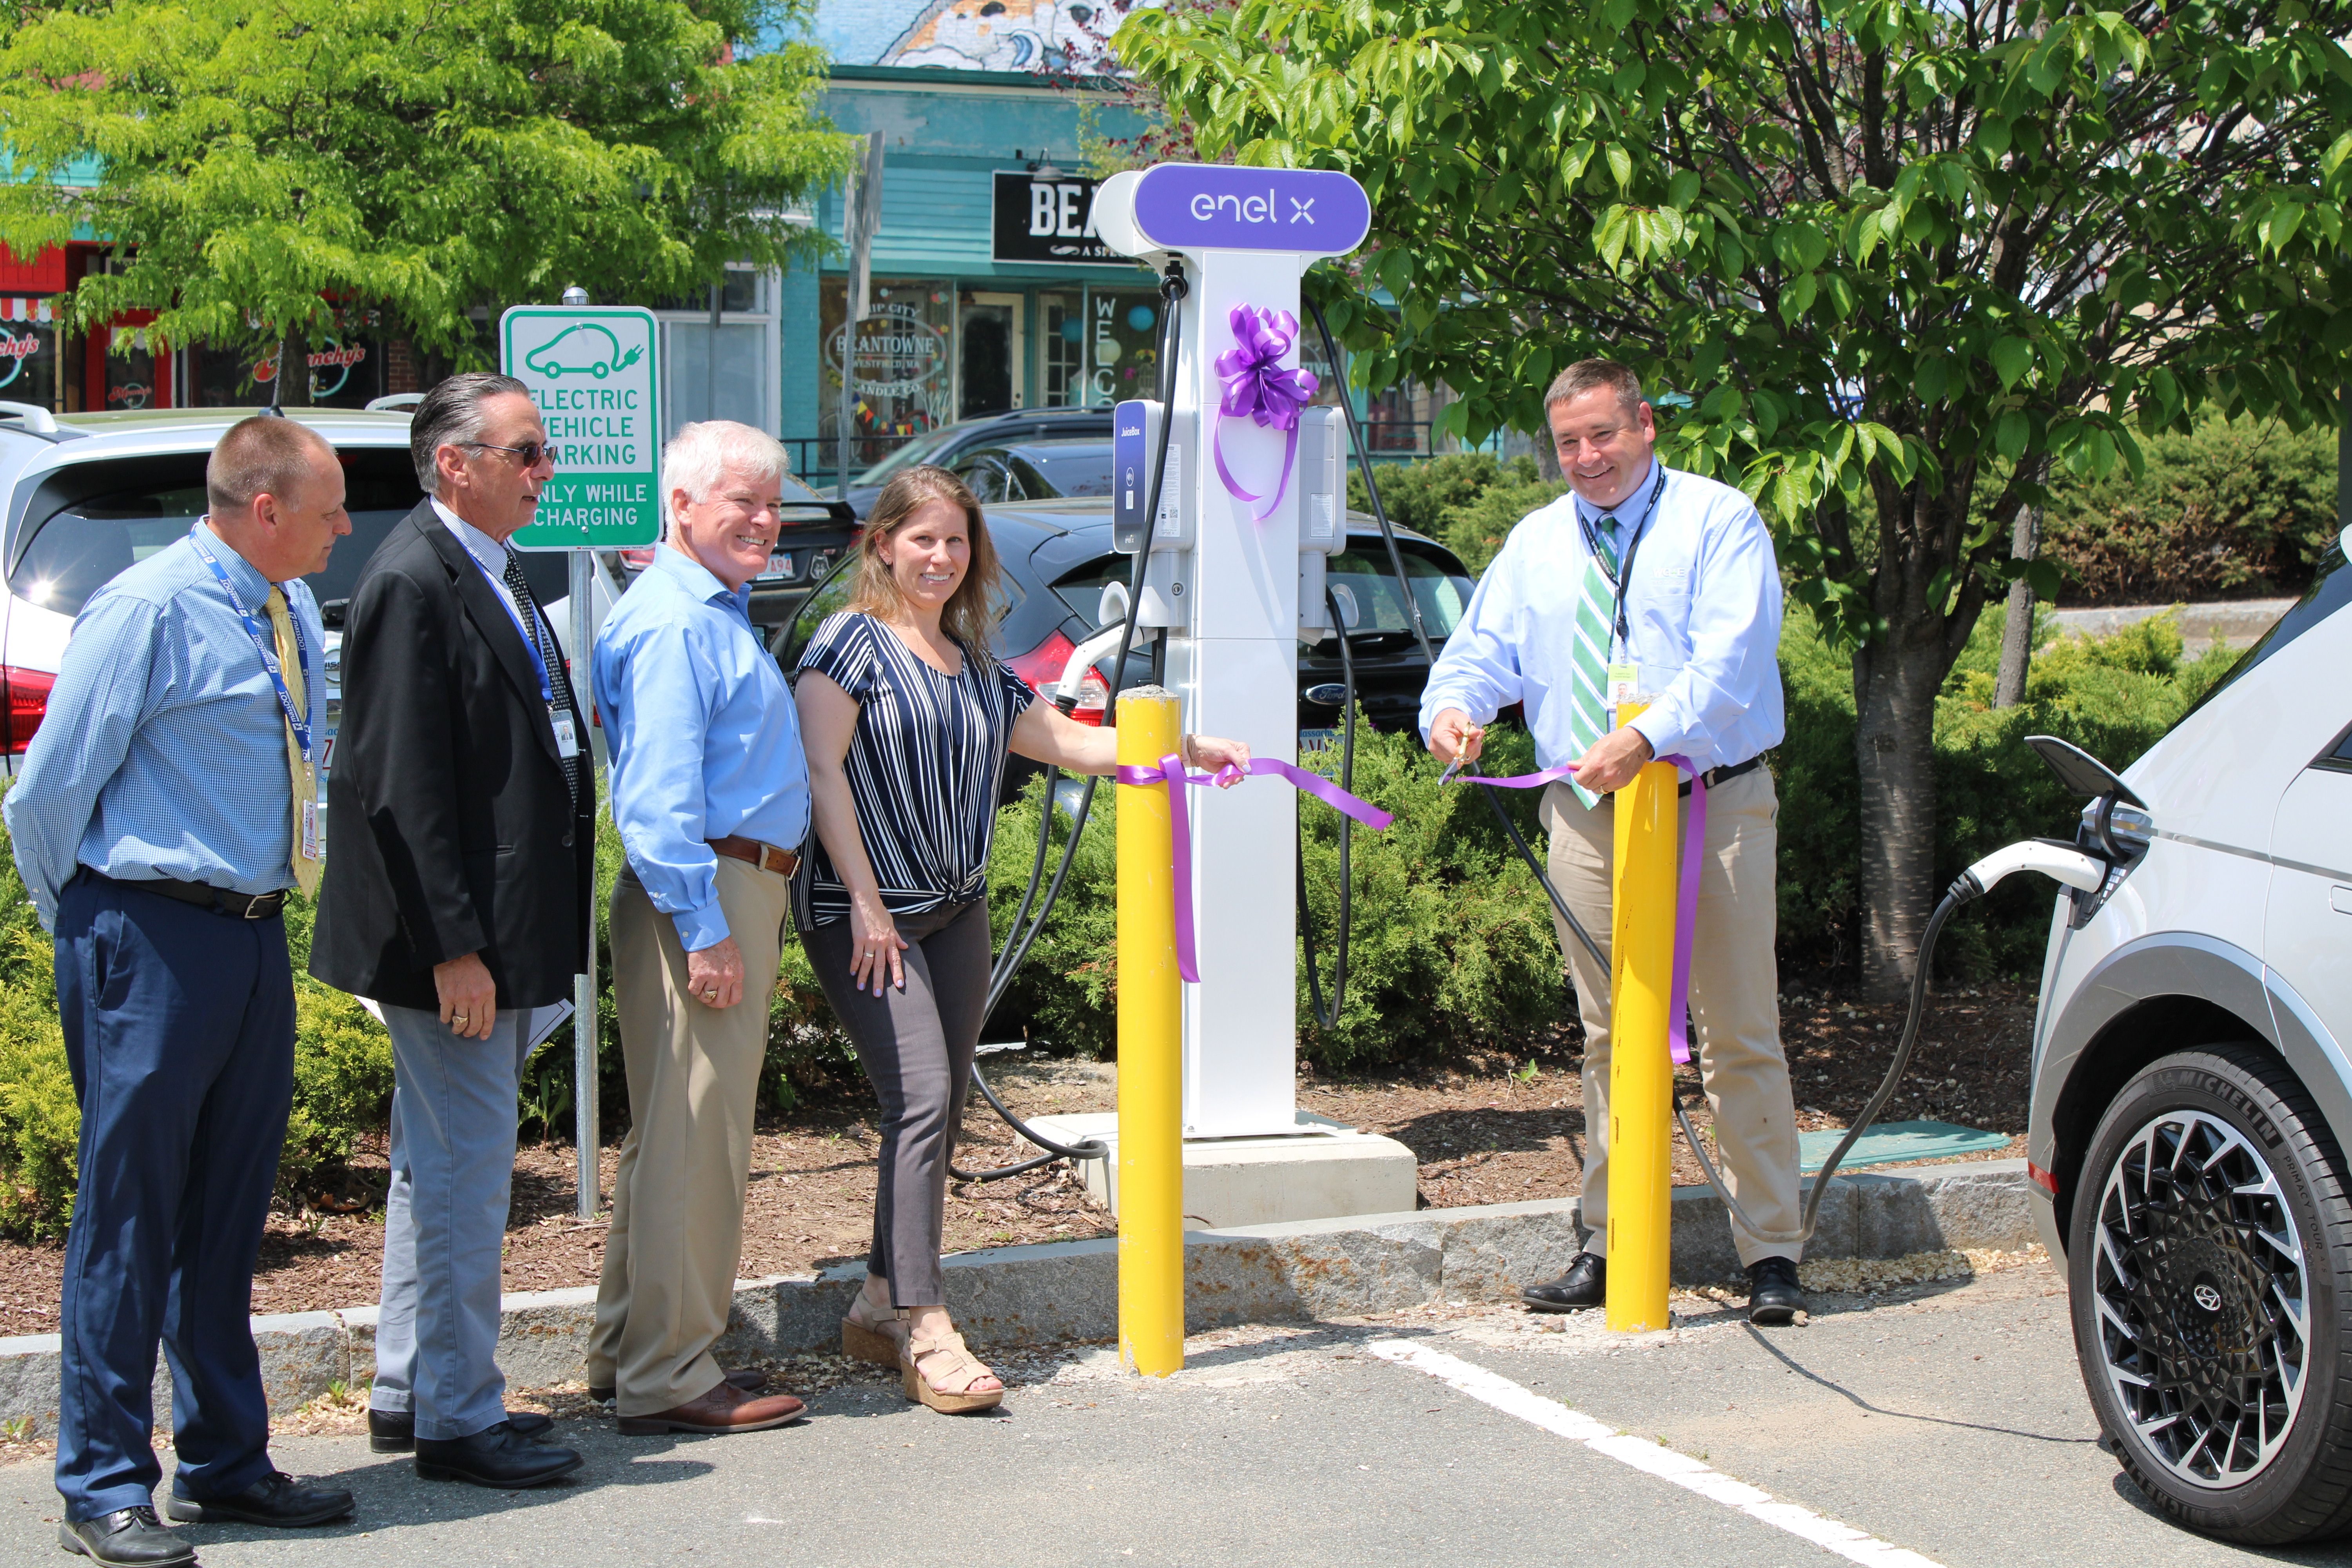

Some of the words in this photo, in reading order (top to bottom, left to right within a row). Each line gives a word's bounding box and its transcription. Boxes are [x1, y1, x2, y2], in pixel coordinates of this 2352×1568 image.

[1191, 189, 1278, 223] enel
[1290, 197, 1315, 225] x
[1082, 246, 1091, 256] A
[889, 303, 921, 318] CITY
[307, 342, 366, 368] nchy's
[836, 336, 935, 354] BANTOWNE
[860, 384, 900, 397] ANDLE
[1122, 426, 1140, 437] JuiceBox
[554, 444, 636, 465] RKING
[537, 485, 577, 503] NLY
[586, 484, 647, 502] WHILE
[534, 507, 637, 526] CHARGING
[190, 537, 208, 557] massDOT
[220, 579, 242, 609] massDOT
[292, 619, 306, 652] massDOT
[251, 634, 272, 665] massDOT
[1319, 688, 1345, 699] Ford
[278, 691, 297, 724] massDOT
[1300, 728, 1337, 737] assachu
[2178, 1071, 2277, 1141] MICHELIN
[2283, 1156, 2312, 1208] PRIMACY
[2308, 1214, 2323, 1250] TOUR
[2118, 1446, 2207, 1526] MICHELIN
